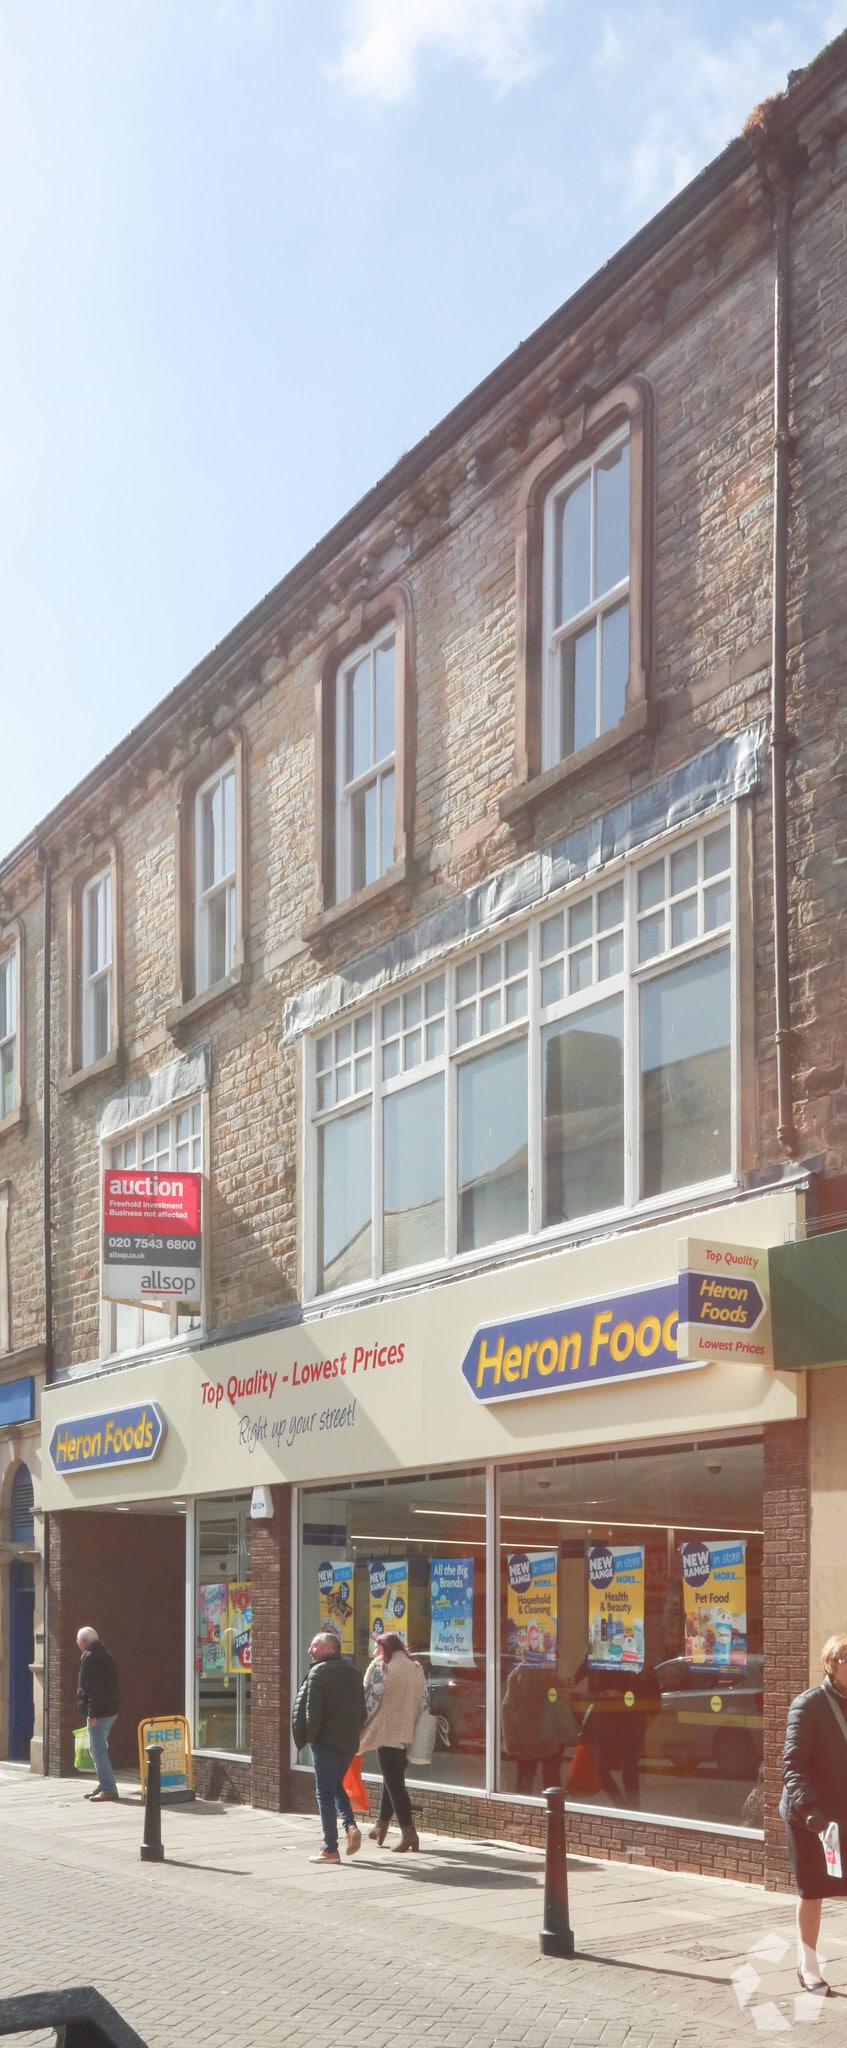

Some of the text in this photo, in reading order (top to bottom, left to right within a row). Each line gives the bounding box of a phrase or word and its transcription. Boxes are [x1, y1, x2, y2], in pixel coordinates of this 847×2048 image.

[110, 1176, 183, 1197] auction
[109, 1200, 183, 1210] Freehold investment
[109, 1209, 142, 1217] Business
[158, 1211, 188, 1219] affected
[109, 1238, 196, 1250] 020 7543 6800
[109, 1251, 145, 1260] allsop.co.uk
[705, 1249, 759, 1269] Top Quality
[141, 1270, 195, 1294] allsop
[699, 1279, 748, 1302] Heron
[700, 1302, 748, 1323] Foods
[699, 1338, 765, 1356] Lowest Prices
[476, 1331, 582, 1388] Heron
[200, 1382, 224, 1409] Top
[227, 1369, 278, 1406] Quality
[292, 1352, 347, 1387] Lowest
[352, 1342, 405, 1374] Prices
[238, 1399, 357, 1454] Right up your street!
[55, 1412, 153, 1463] Heron Foods
[590, 1556, 641, 1572] NEW in store
[683, 1551, 741, 1568] NEW in store
[319, 1569, 334, 1581] NEW
[434, 1564, 468, 1579] All the Big
[509, 1562, 530, 1577] NEW
[540, 1562, 554, 1572] store
[590, 1568, 613, 1580] RANGE
[684, 1564, 710, 1578] RANGE
[370, 1571, 386, 1582] NEW
[439, 1577, 463, 1588] Brands
[510, 1573, 531, 1585] RANGE
[371, 1581, 387, 1591] RANGE
[517, 1593, 551, 1604] Household
[605, 1591, 628, 1602] Health
[695, 1592, 730, 1603] Pet Food
[518, 1605, 551, 1616] & Cleaning
[600, 1603, 632, 1614] & Beauty
[438, 1634, 464, 1646] Ready for
[146, 1728, 181, 1743] FREE
